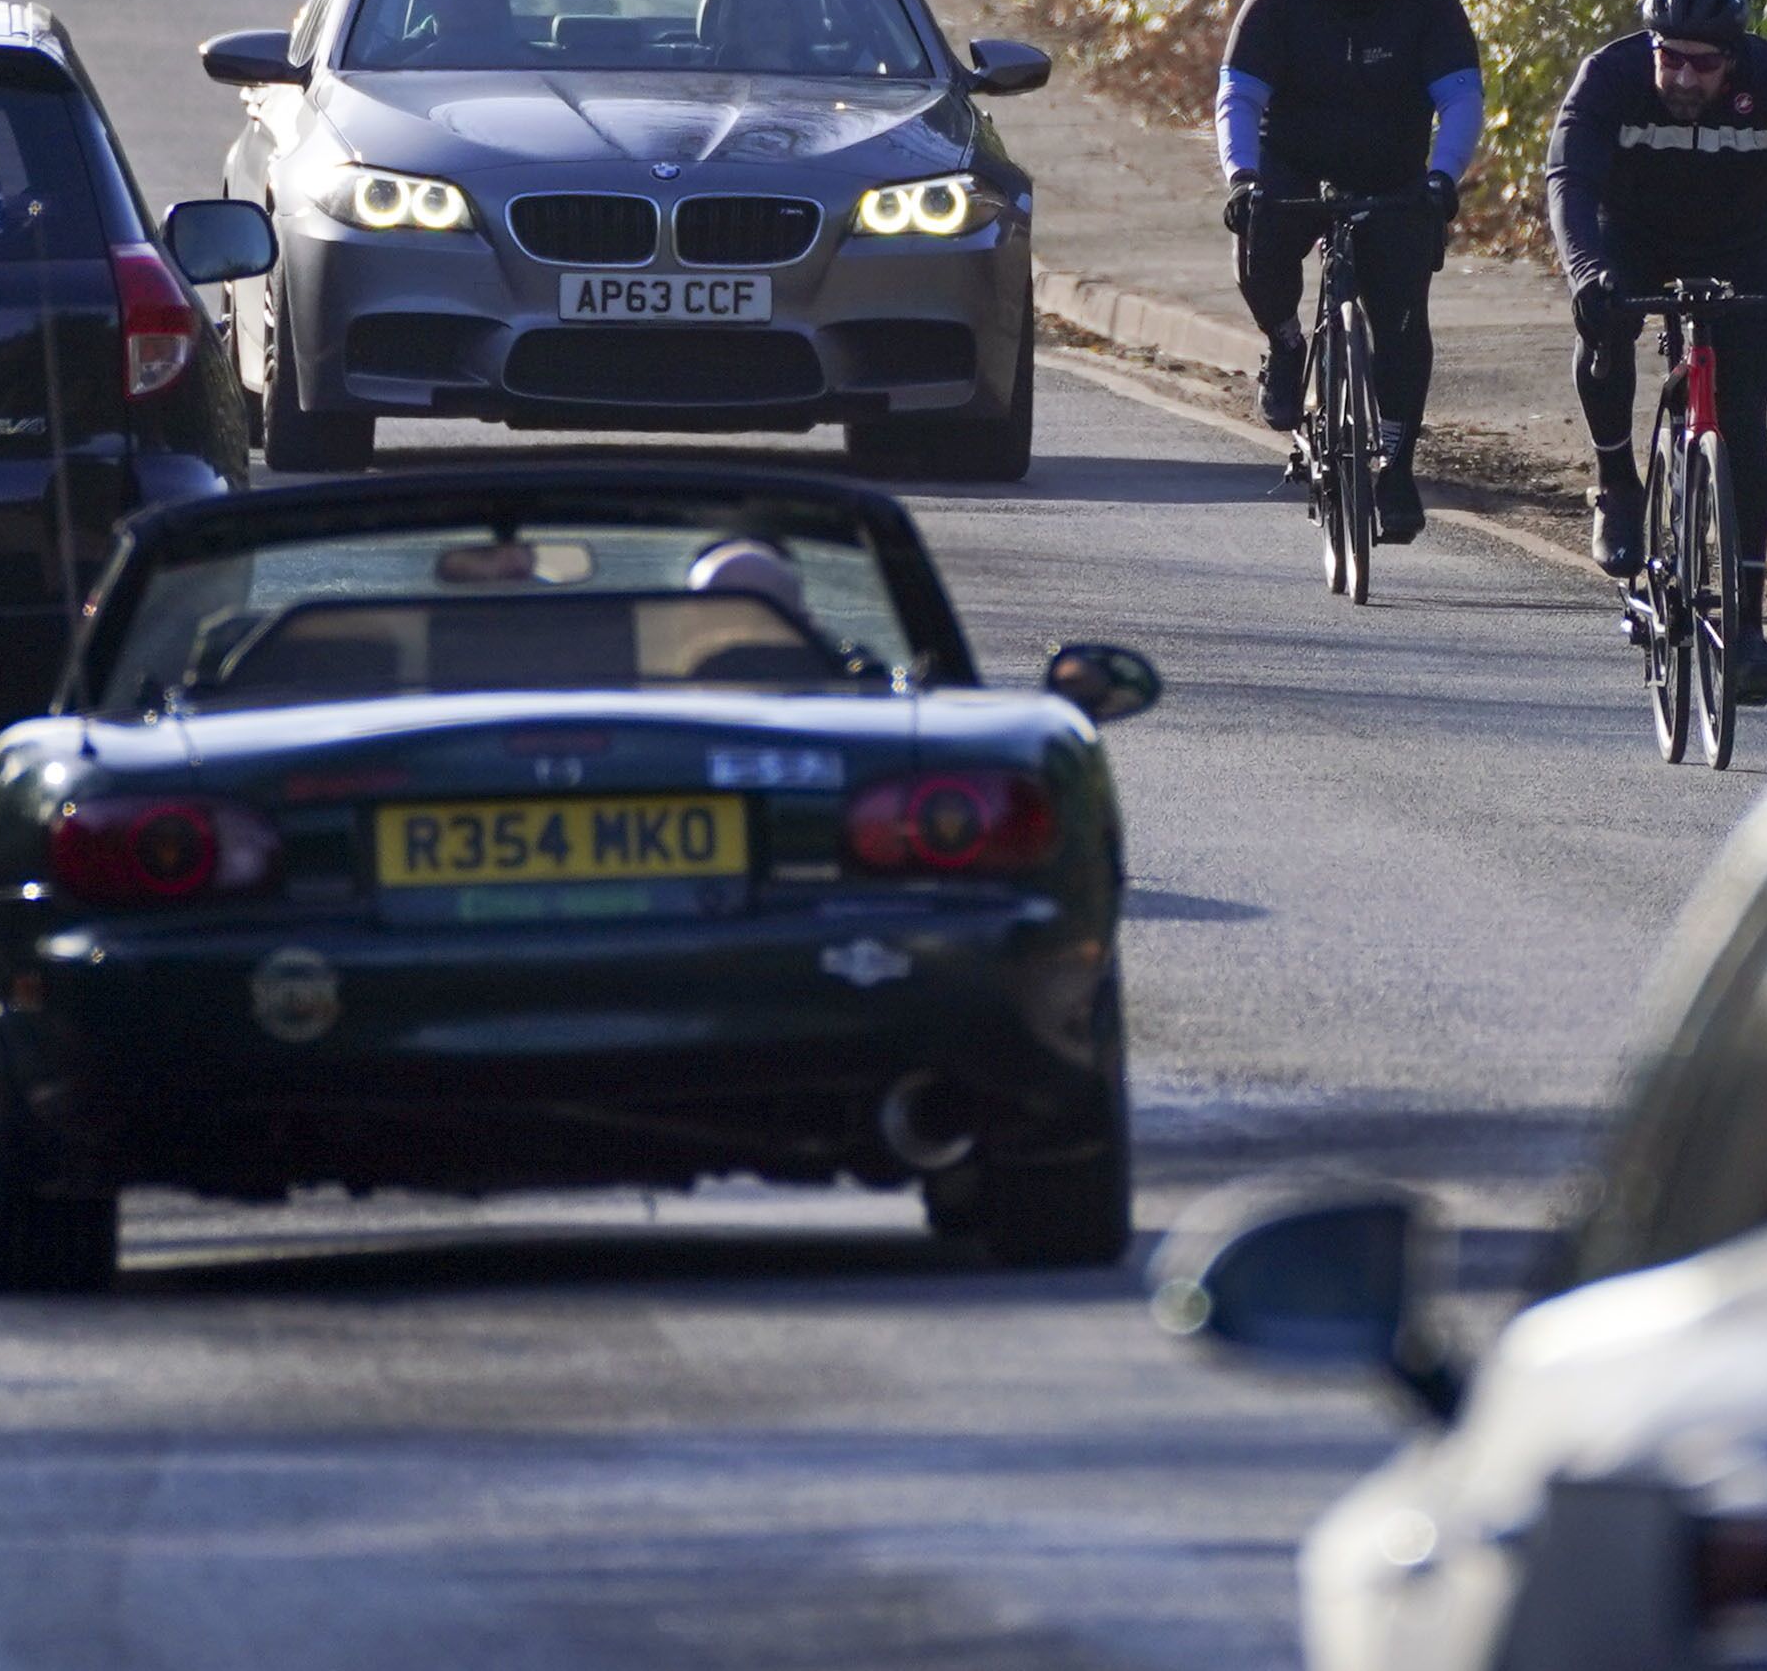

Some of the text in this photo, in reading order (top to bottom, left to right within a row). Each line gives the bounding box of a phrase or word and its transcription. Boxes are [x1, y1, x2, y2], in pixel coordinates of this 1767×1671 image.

[576, 280, 755, 315] AP63 CCF
[402, 807, 718, 873] R354 MKO
